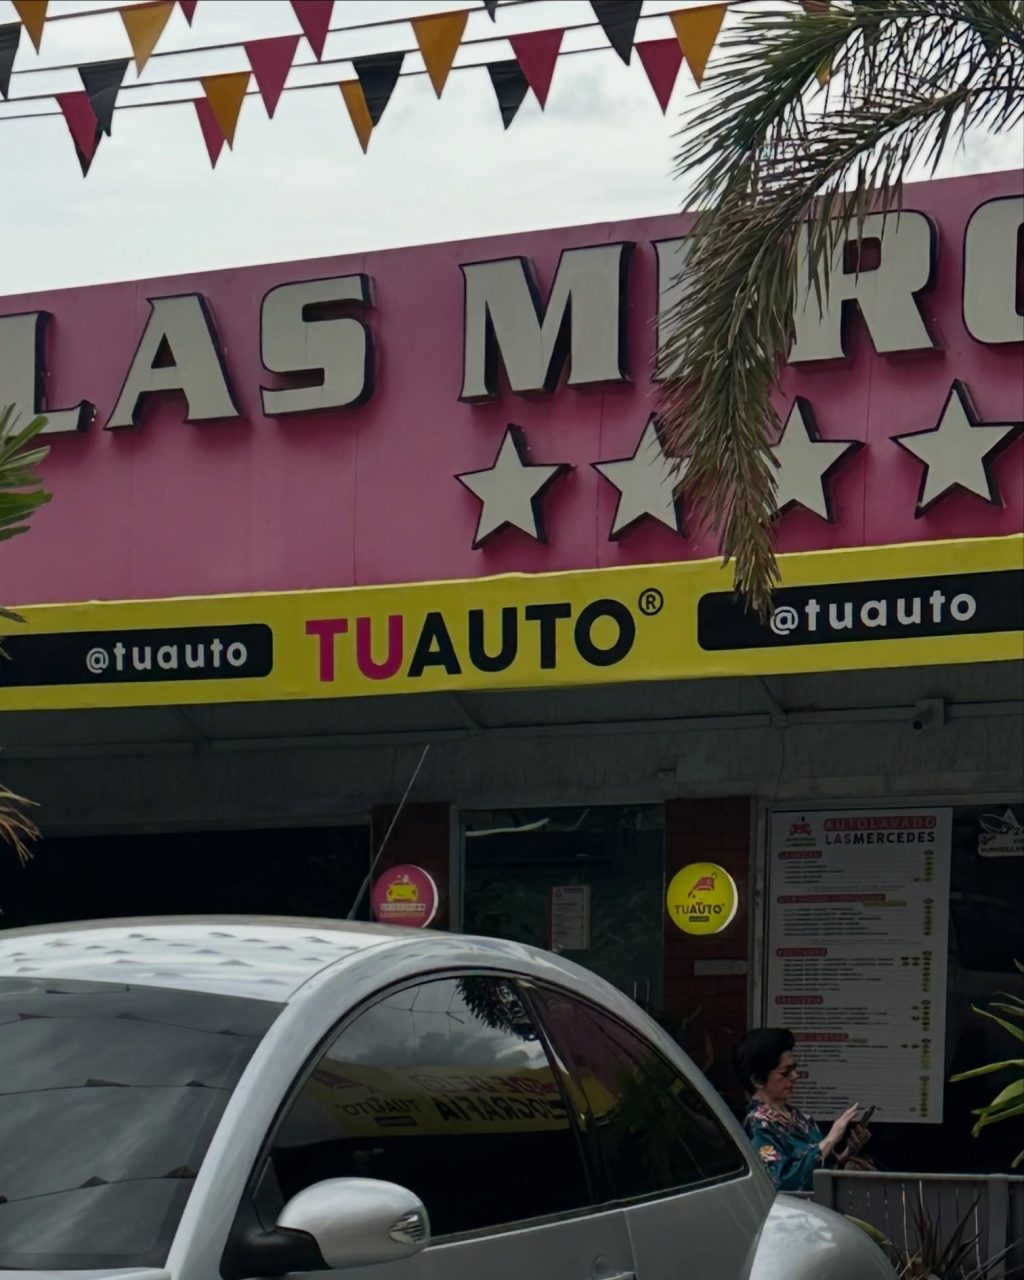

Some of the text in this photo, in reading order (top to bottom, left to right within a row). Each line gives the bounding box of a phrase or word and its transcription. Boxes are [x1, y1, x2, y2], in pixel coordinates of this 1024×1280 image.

[458, 194, 1024, 402] MR
[770, 589, 977, 635] @tuauto
[86, 637, 248, 674] @tuauto
[825, 816, 936, 831] AUTOLAVADO
[674, 903, 722, 915] TUAUTO
